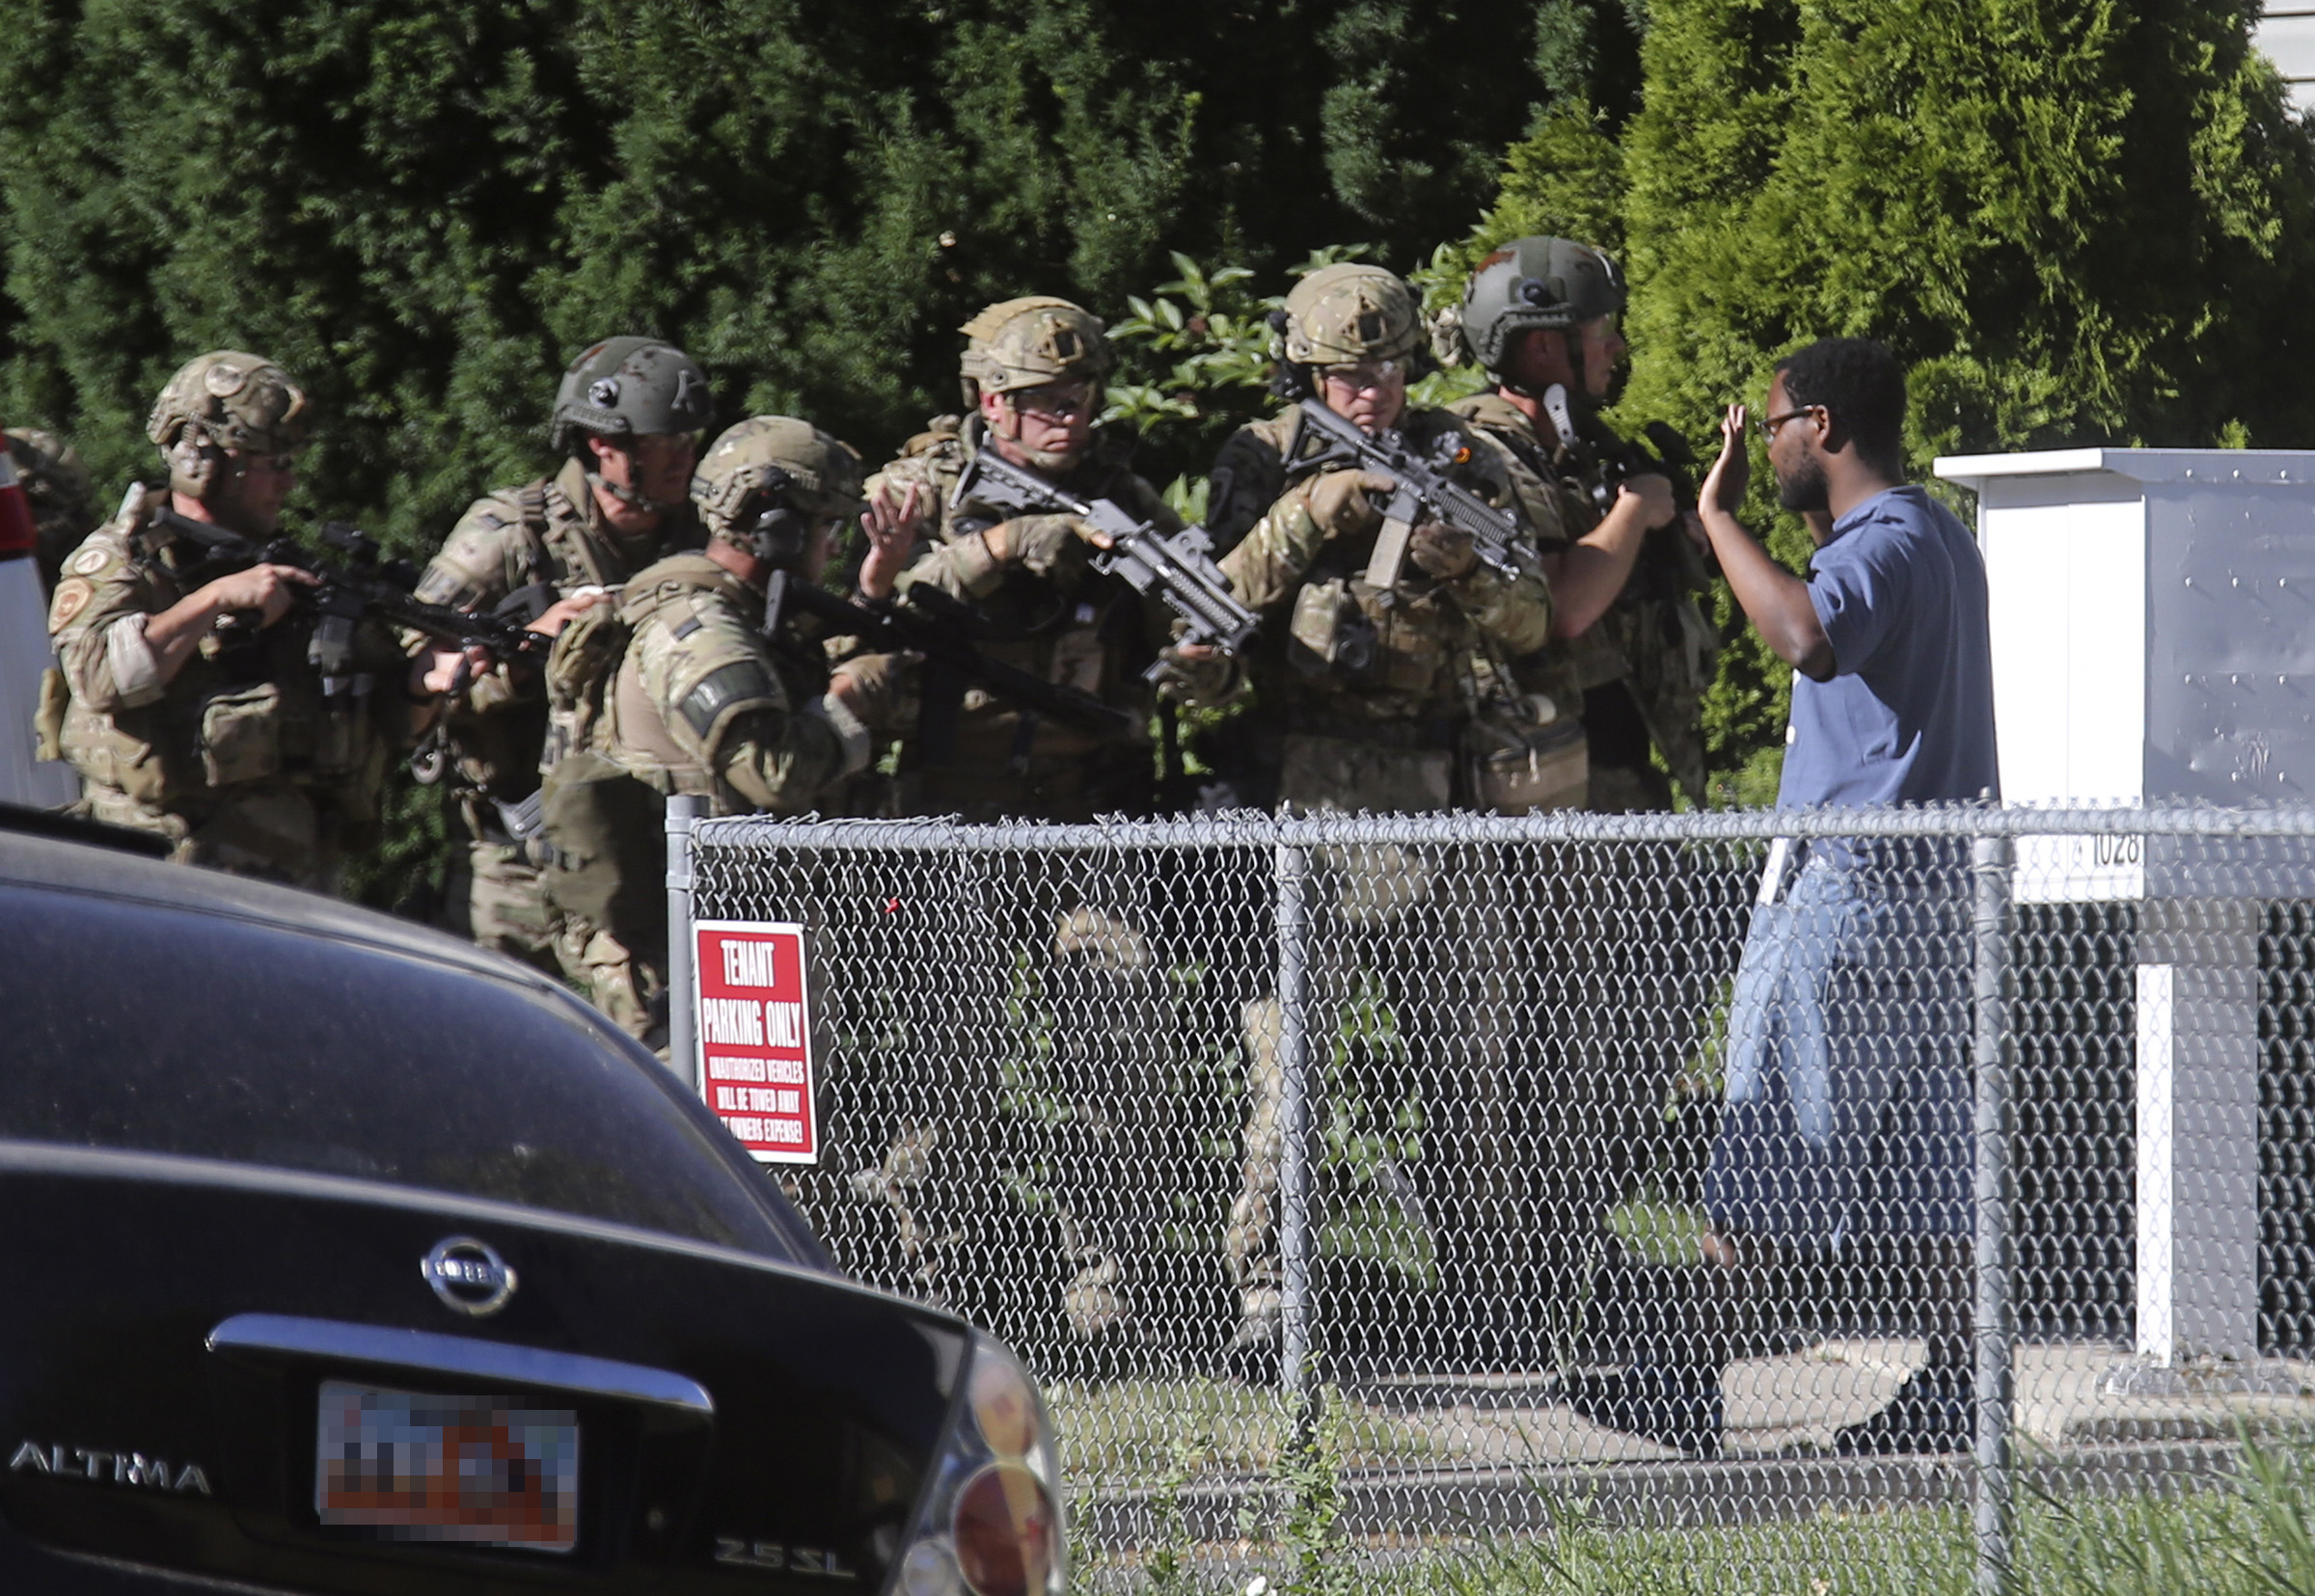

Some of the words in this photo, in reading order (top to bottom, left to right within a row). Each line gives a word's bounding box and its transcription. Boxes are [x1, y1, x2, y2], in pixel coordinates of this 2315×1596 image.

[721, 939, 776, 987] TENANT
[703, 998, 763, 1046] PARKING
[765, 1000, 802, 1048] ONLY
[709, 1056, 766, 1082] UNAUTHORIZED
[766, 1059, 804, 1085] VEHICLES
[717, 1086, 736, 1110] WILL
[737, 1087, 749, 1111] BE
[749, 1087, 776, 1112] TOWED
[777, 1090, 800, 1114] AWAY
[9, 1443, 212, 1496] ALTIMA
[790, 1548, 857, 1578] SL
